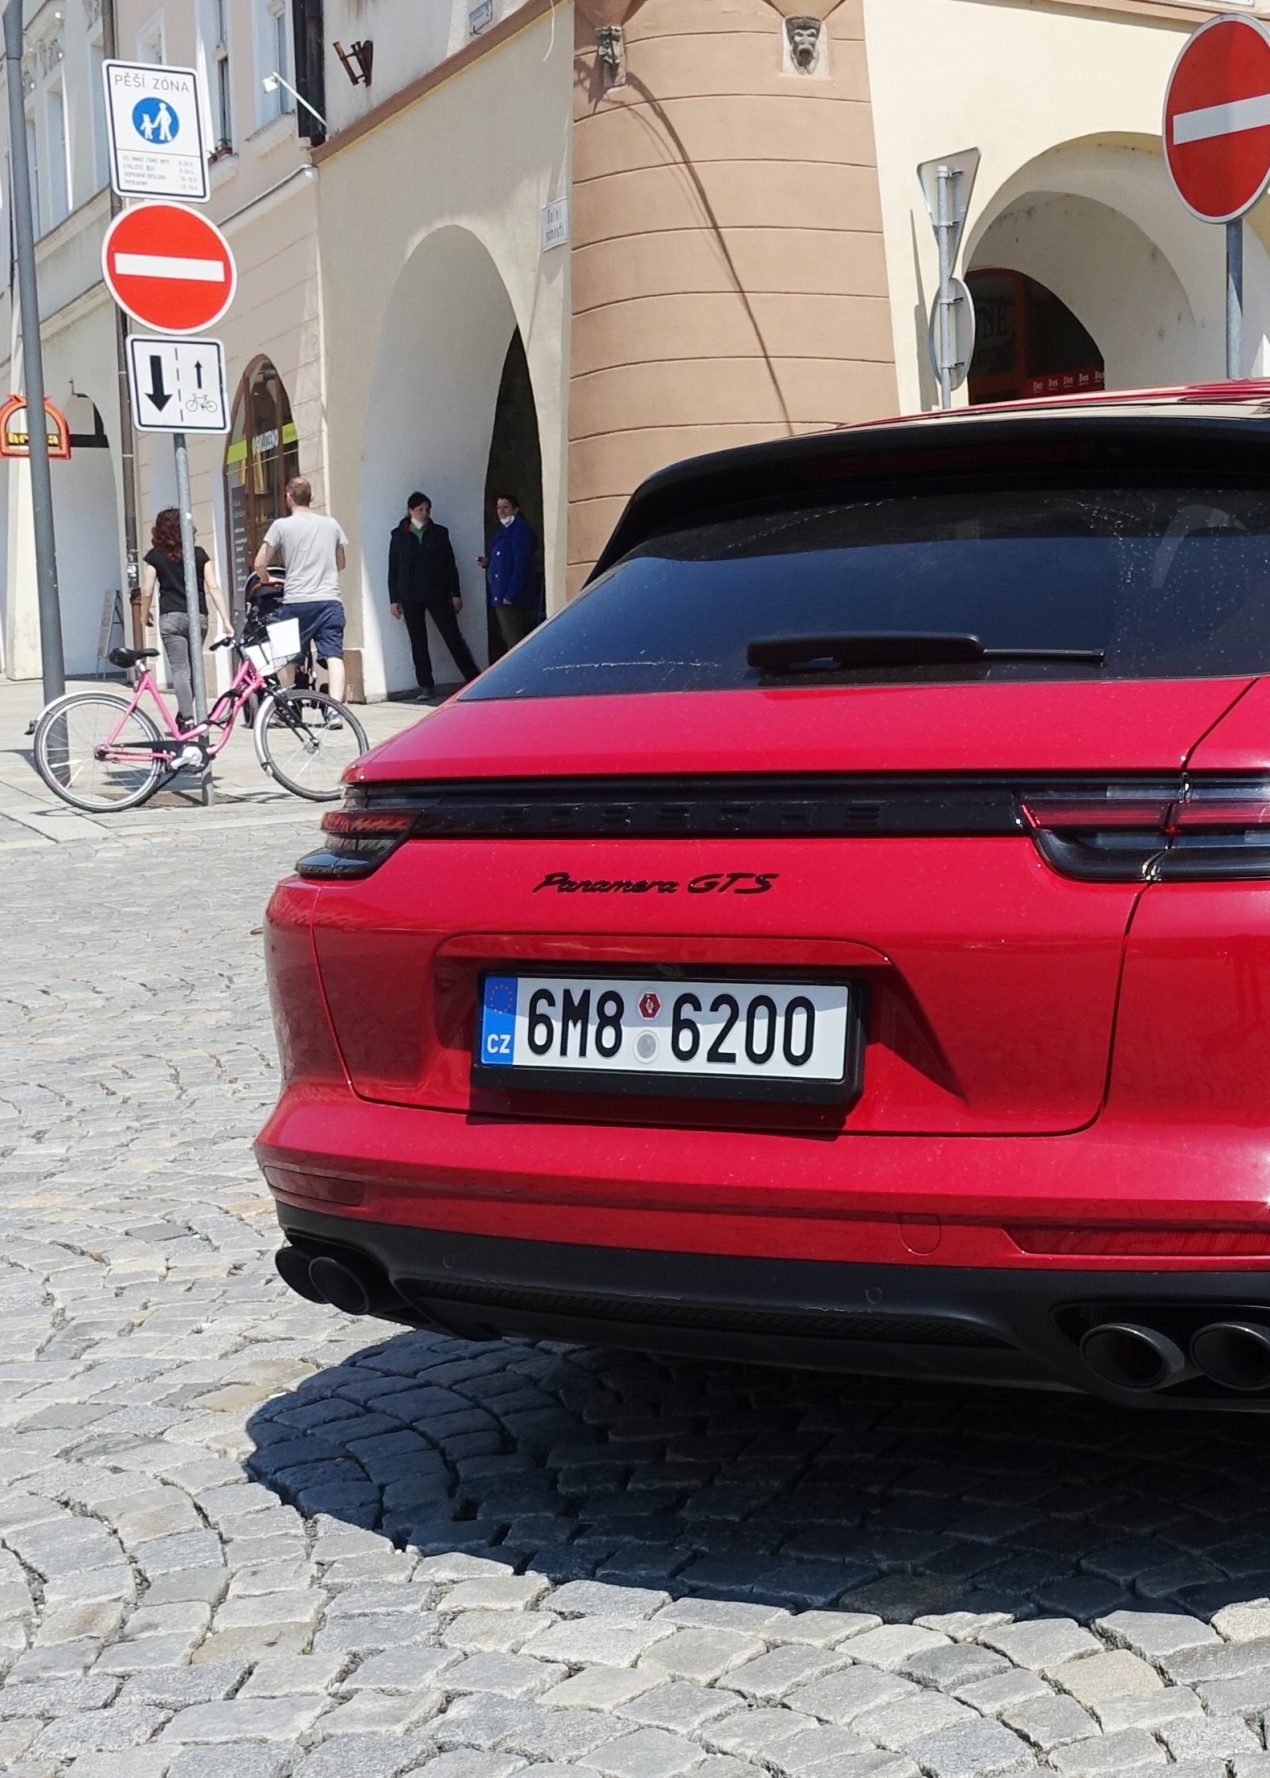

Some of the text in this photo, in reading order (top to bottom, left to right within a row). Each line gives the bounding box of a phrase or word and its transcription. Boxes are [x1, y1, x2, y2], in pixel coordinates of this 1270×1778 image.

[114, 72, 190, 93] PĚŠÍ ZÓNA
[533, 872, 780, 895] Panamera GTS
[527, 988, 816, 1067] 6M8 6200
[487, 1034, 511, 1054] CZ
